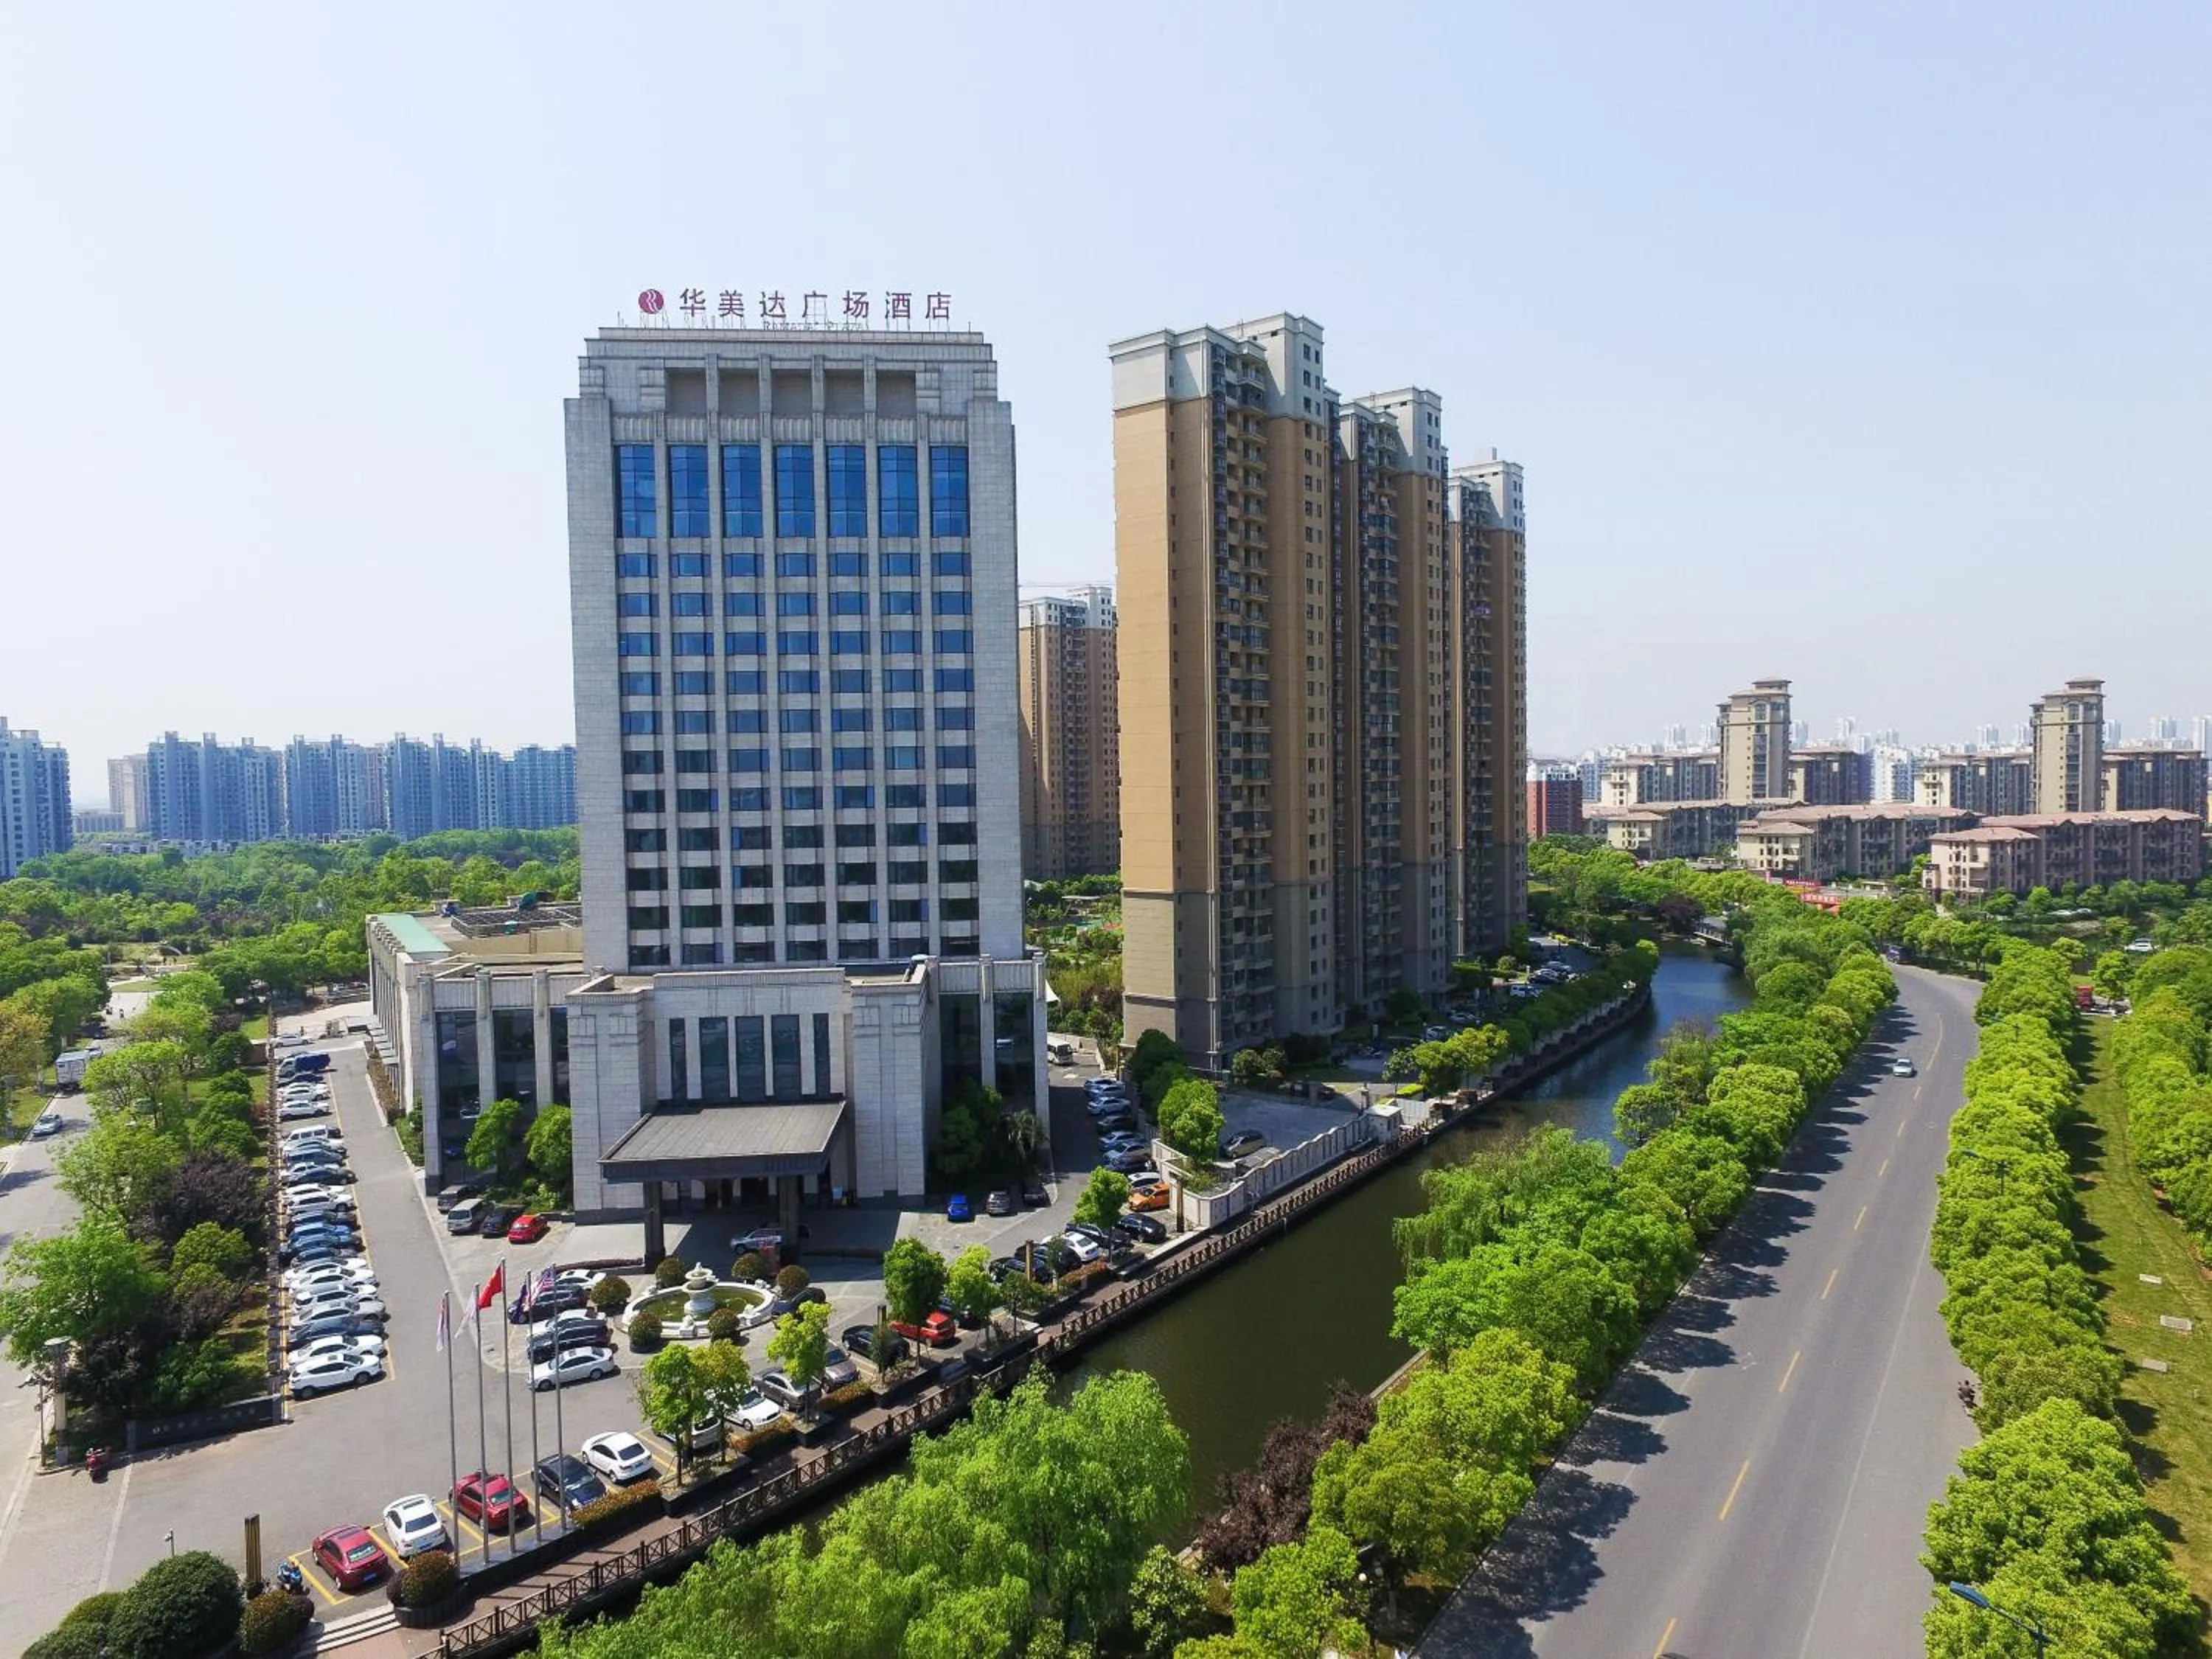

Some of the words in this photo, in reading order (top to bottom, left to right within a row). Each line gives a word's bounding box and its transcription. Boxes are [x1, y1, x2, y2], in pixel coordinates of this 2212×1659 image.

[679, 288, 952, 319] 华美达广场酒店
